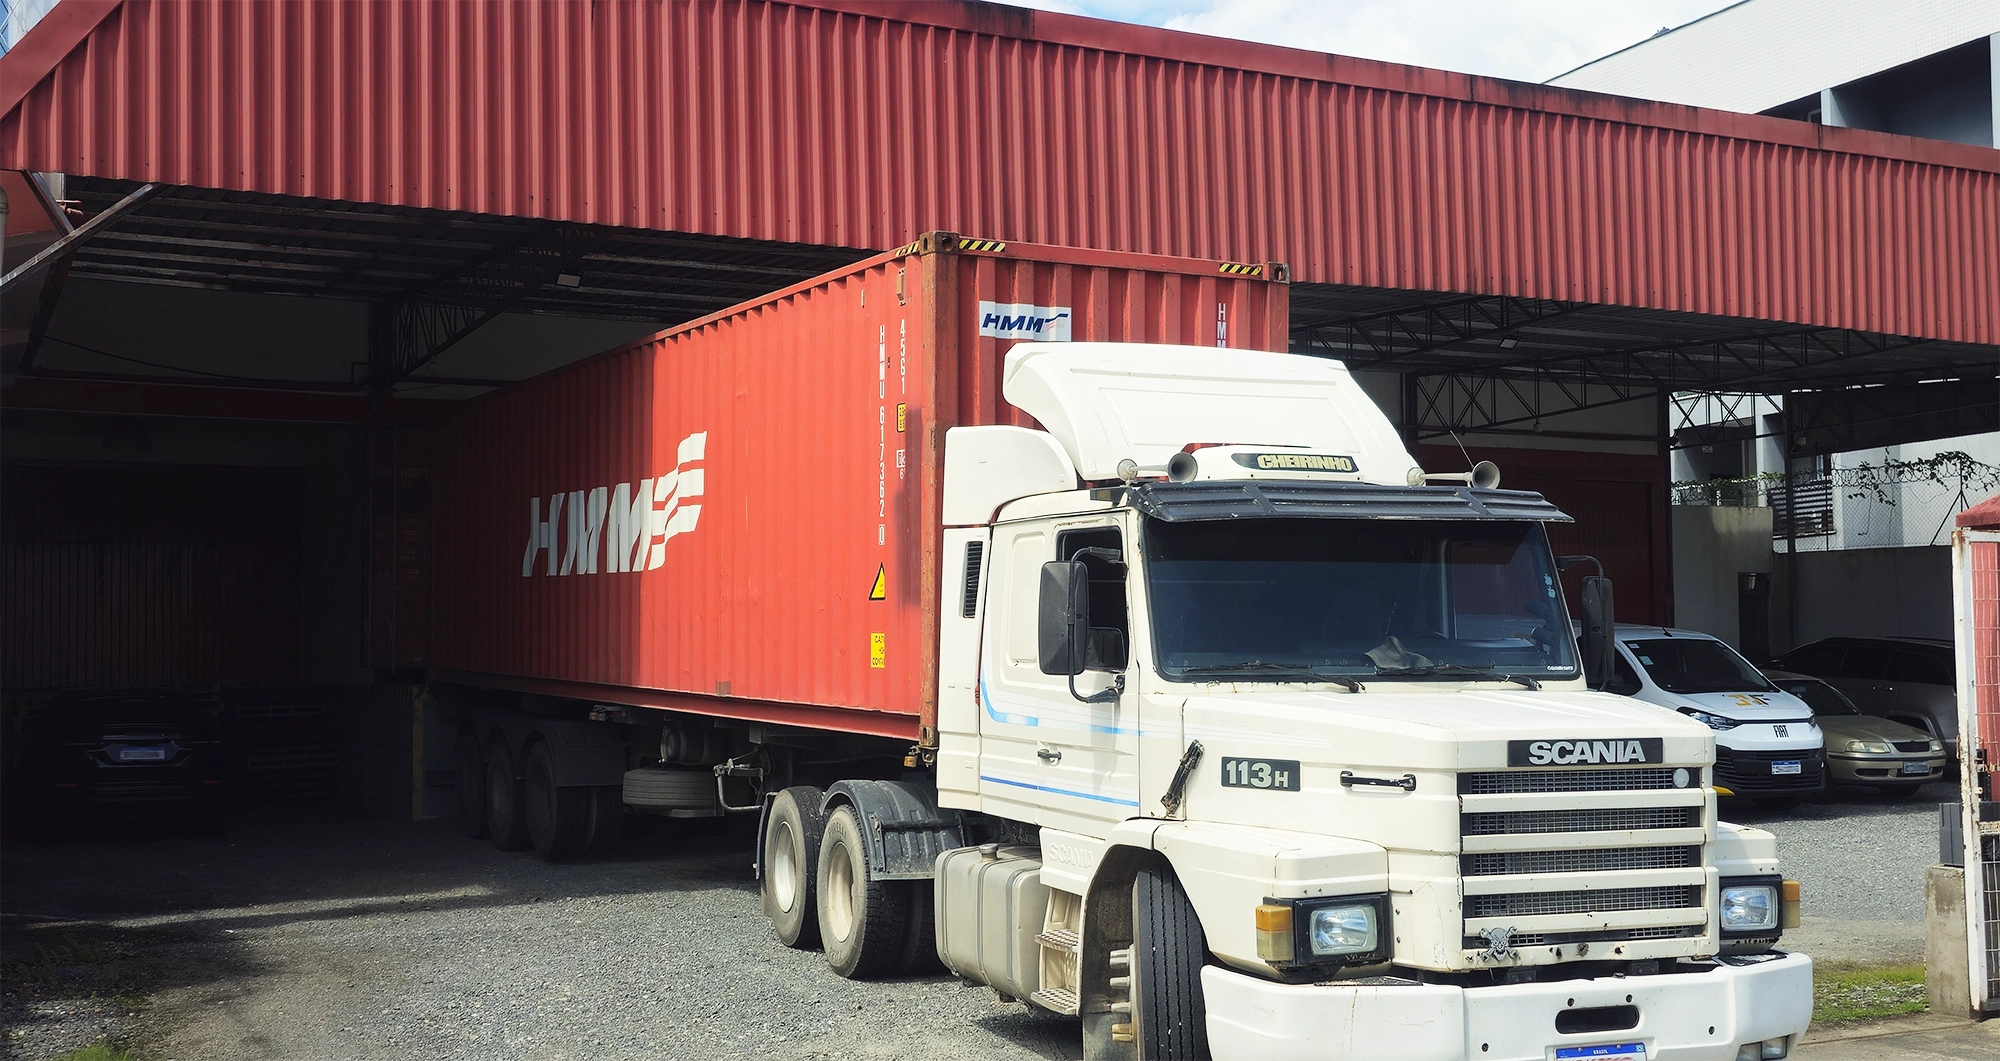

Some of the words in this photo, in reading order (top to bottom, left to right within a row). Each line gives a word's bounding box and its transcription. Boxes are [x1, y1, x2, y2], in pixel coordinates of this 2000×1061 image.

[982, 313, 1045, 333] HMM
[1257, 454, 1353, 471] CHEIRINHO
[522, 478, 654, 577] HMM
[1773, 725, 1789, 738] FIAT
[1528, 740, 1646, 765] SCANIA
[1050, 842, 1095, 869] SCANIA
